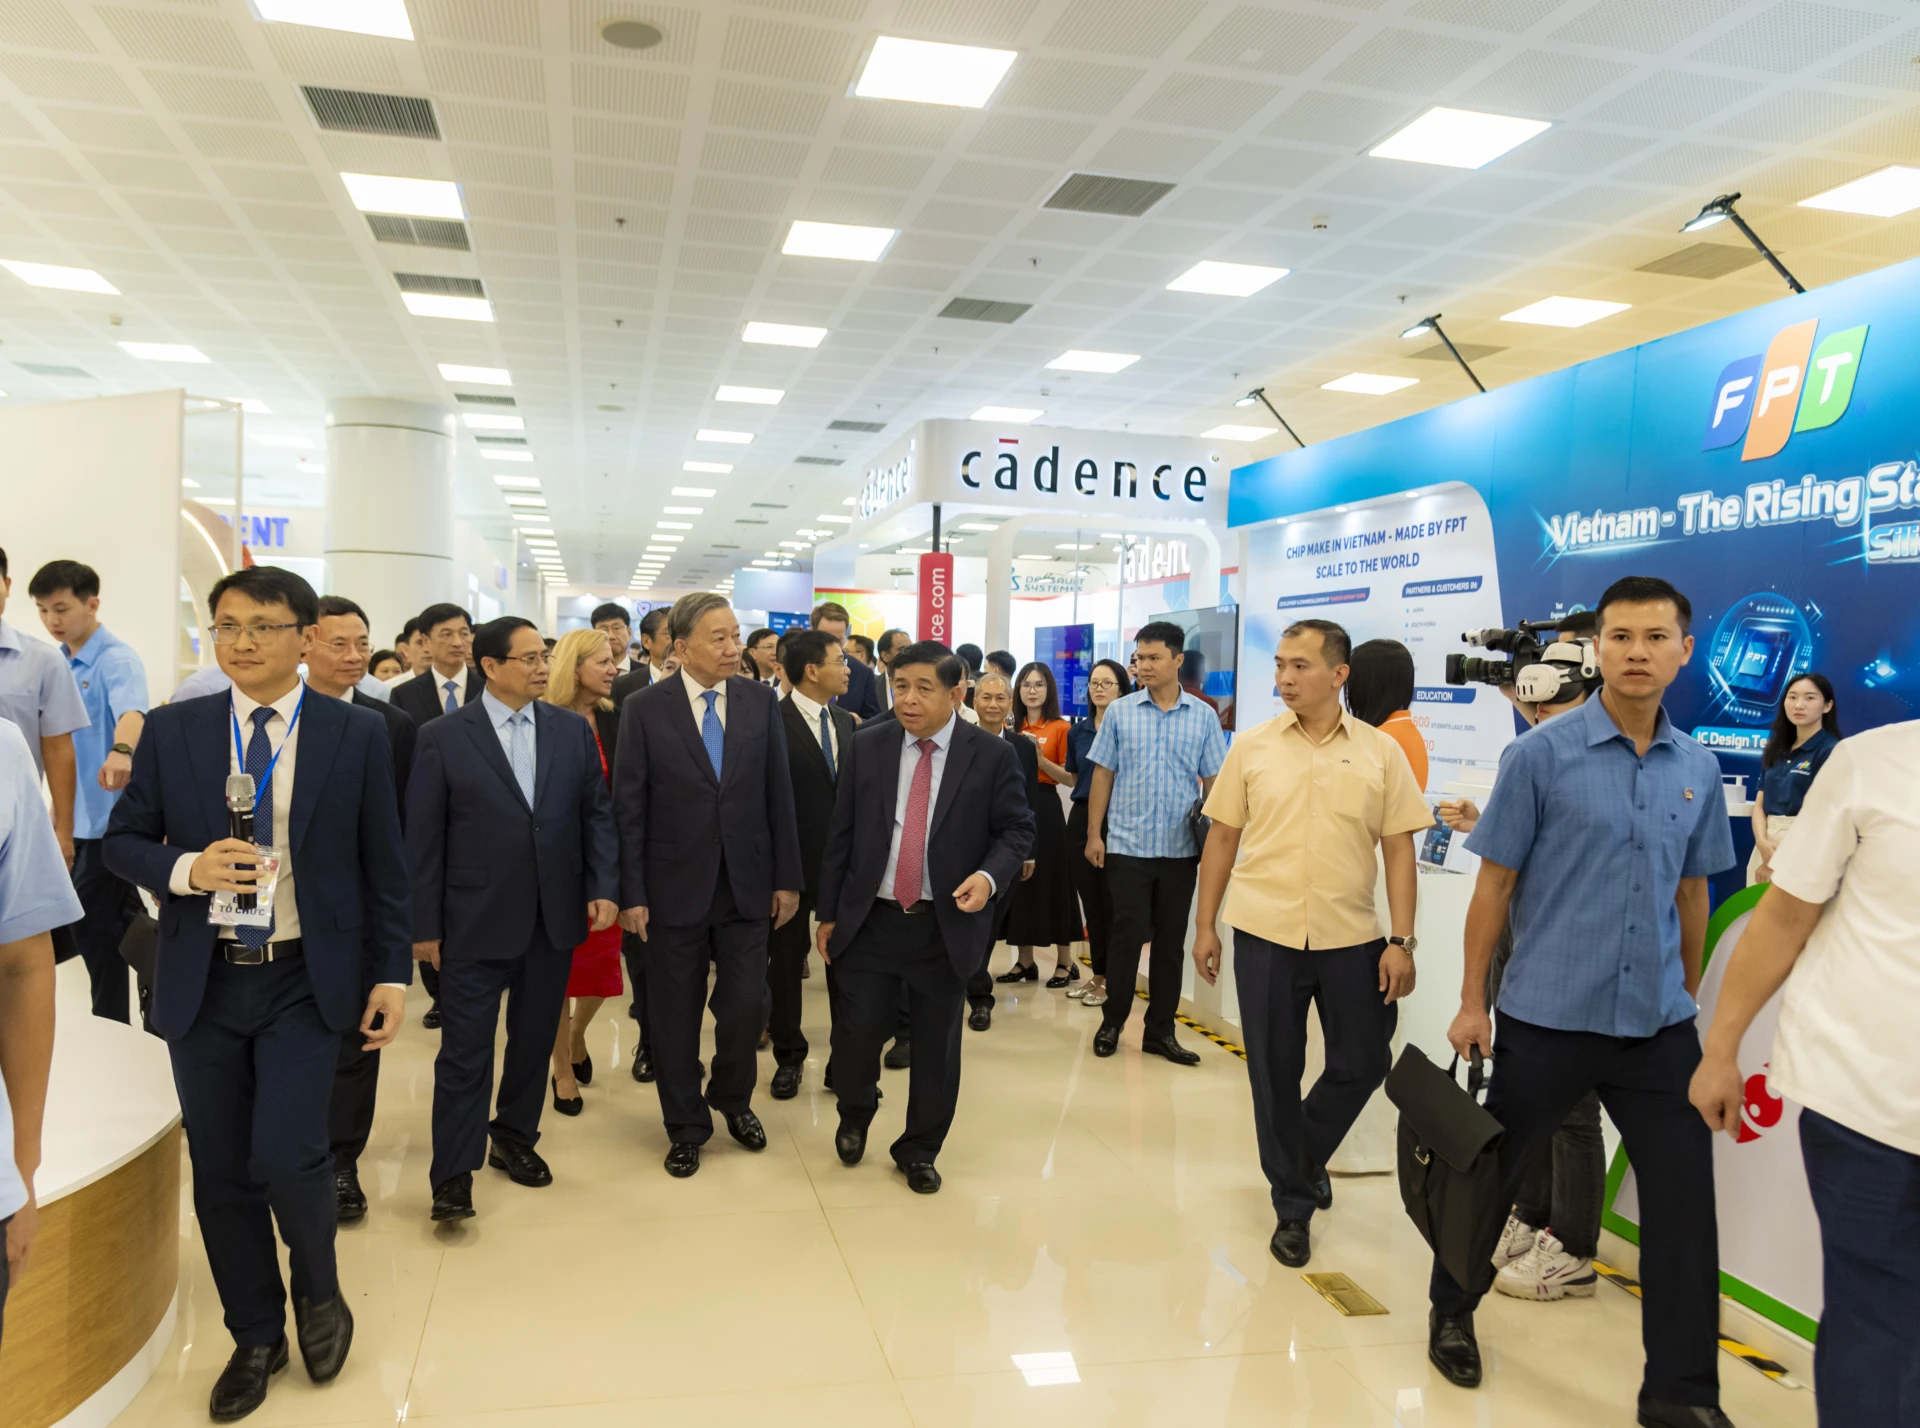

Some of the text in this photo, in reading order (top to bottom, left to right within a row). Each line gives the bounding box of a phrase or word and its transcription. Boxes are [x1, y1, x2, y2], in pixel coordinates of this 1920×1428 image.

[1712, 352, 1853, 428] FPT
[1551, 510, 1657, 547] Vietnam
[1679, 493, 1740, 533] The
[1748, 476, 1861, 525] Rising
[1868, 463, 1920, 508] St
[1286, 543, 1306, 559] CHIP
[1306, 540, 1331, 557] MAKE
[1332, 538, 1342, 552] IN
[1343, 530, 1386, 550] VIETNAM
[1395, 523, 1425, 542] MADE
[1427, 520, 1443, 537] BY
[1445, 516, 1467, 535] FPT
[1868, 525, 1920, 560] Sili
[1316, 552, 1420, 579] SCALE TO THE WORLD
[1405, 585, 1431, 595] PARTNERS
[1436, 582, 1469, 592] CUSTOMERS
[1745, 651, 1768, 665] FPT
[1416, 691, 1453, 701] EDUCATION
[1697, 731, 1768, 750] IC Design Te
